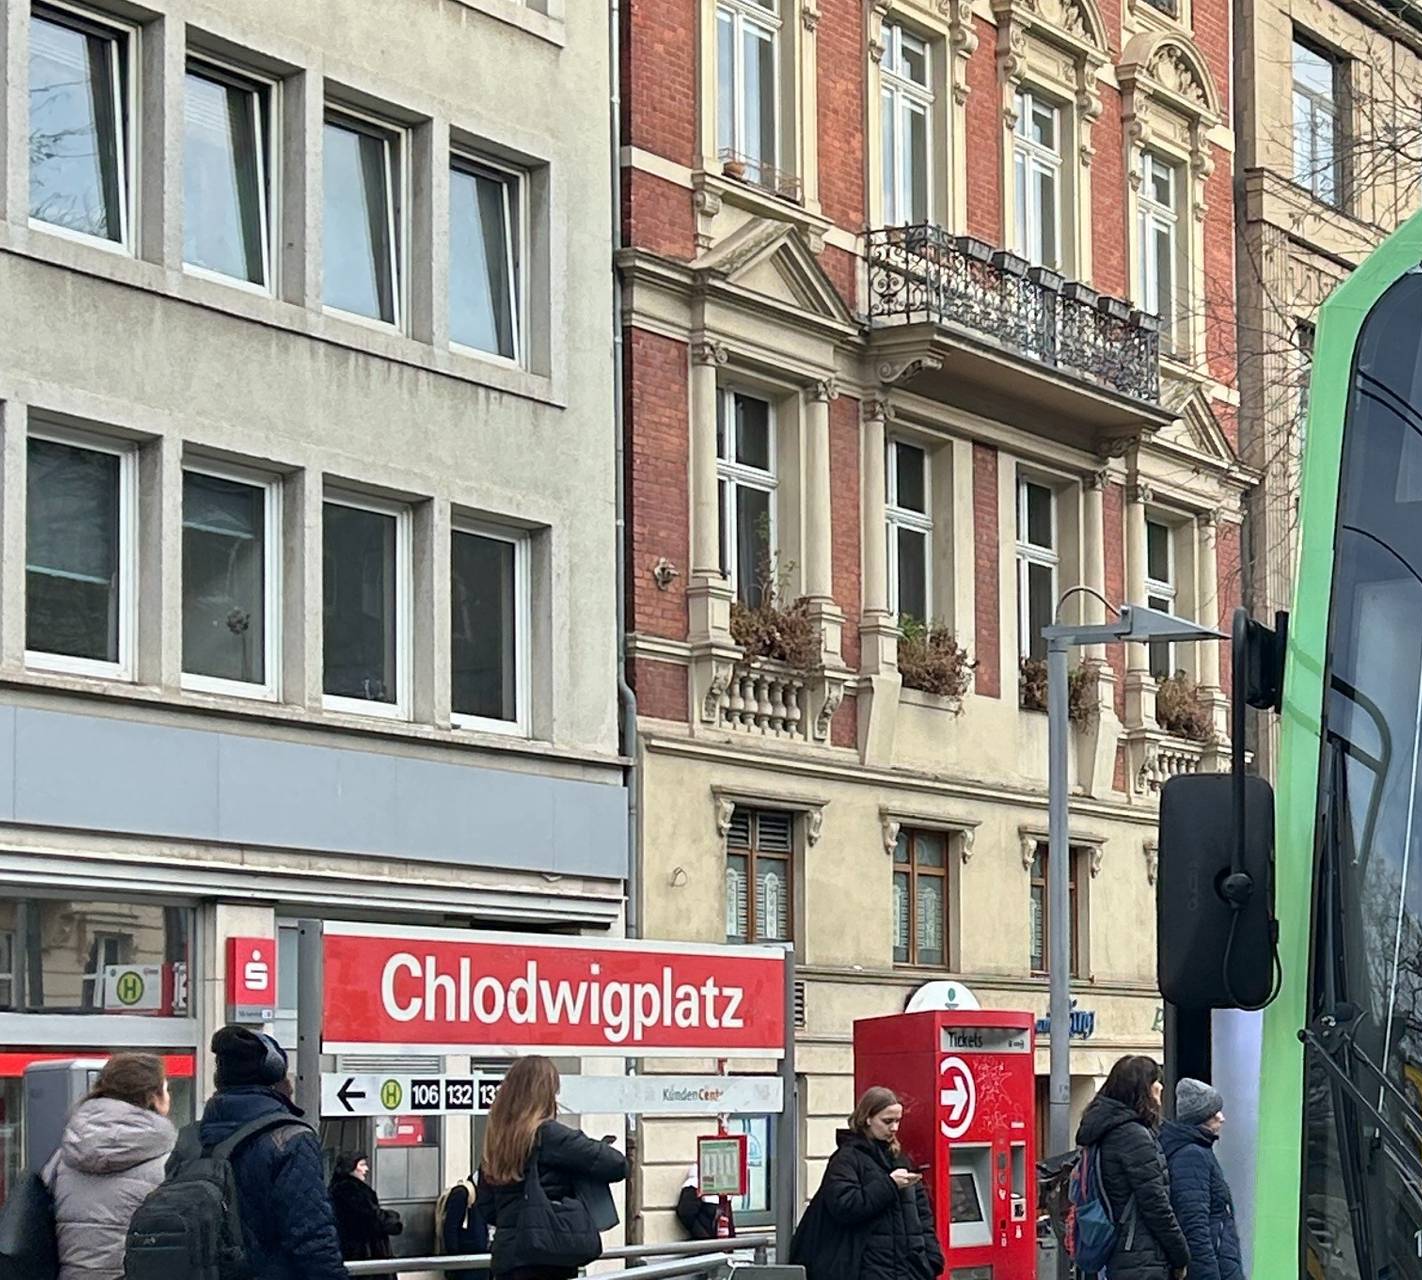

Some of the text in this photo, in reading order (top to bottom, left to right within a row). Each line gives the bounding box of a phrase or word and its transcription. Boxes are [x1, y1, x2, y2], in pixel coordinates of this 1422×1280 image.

[381, 952, 744, 1043] Chlodwigplatz
[948, 1031, 983, 1048] Tickets
[412, 1085, 439, 1105] 106
[447, 1085, 472, 1105] 132
[480, 1085, 500, 1105] 13
